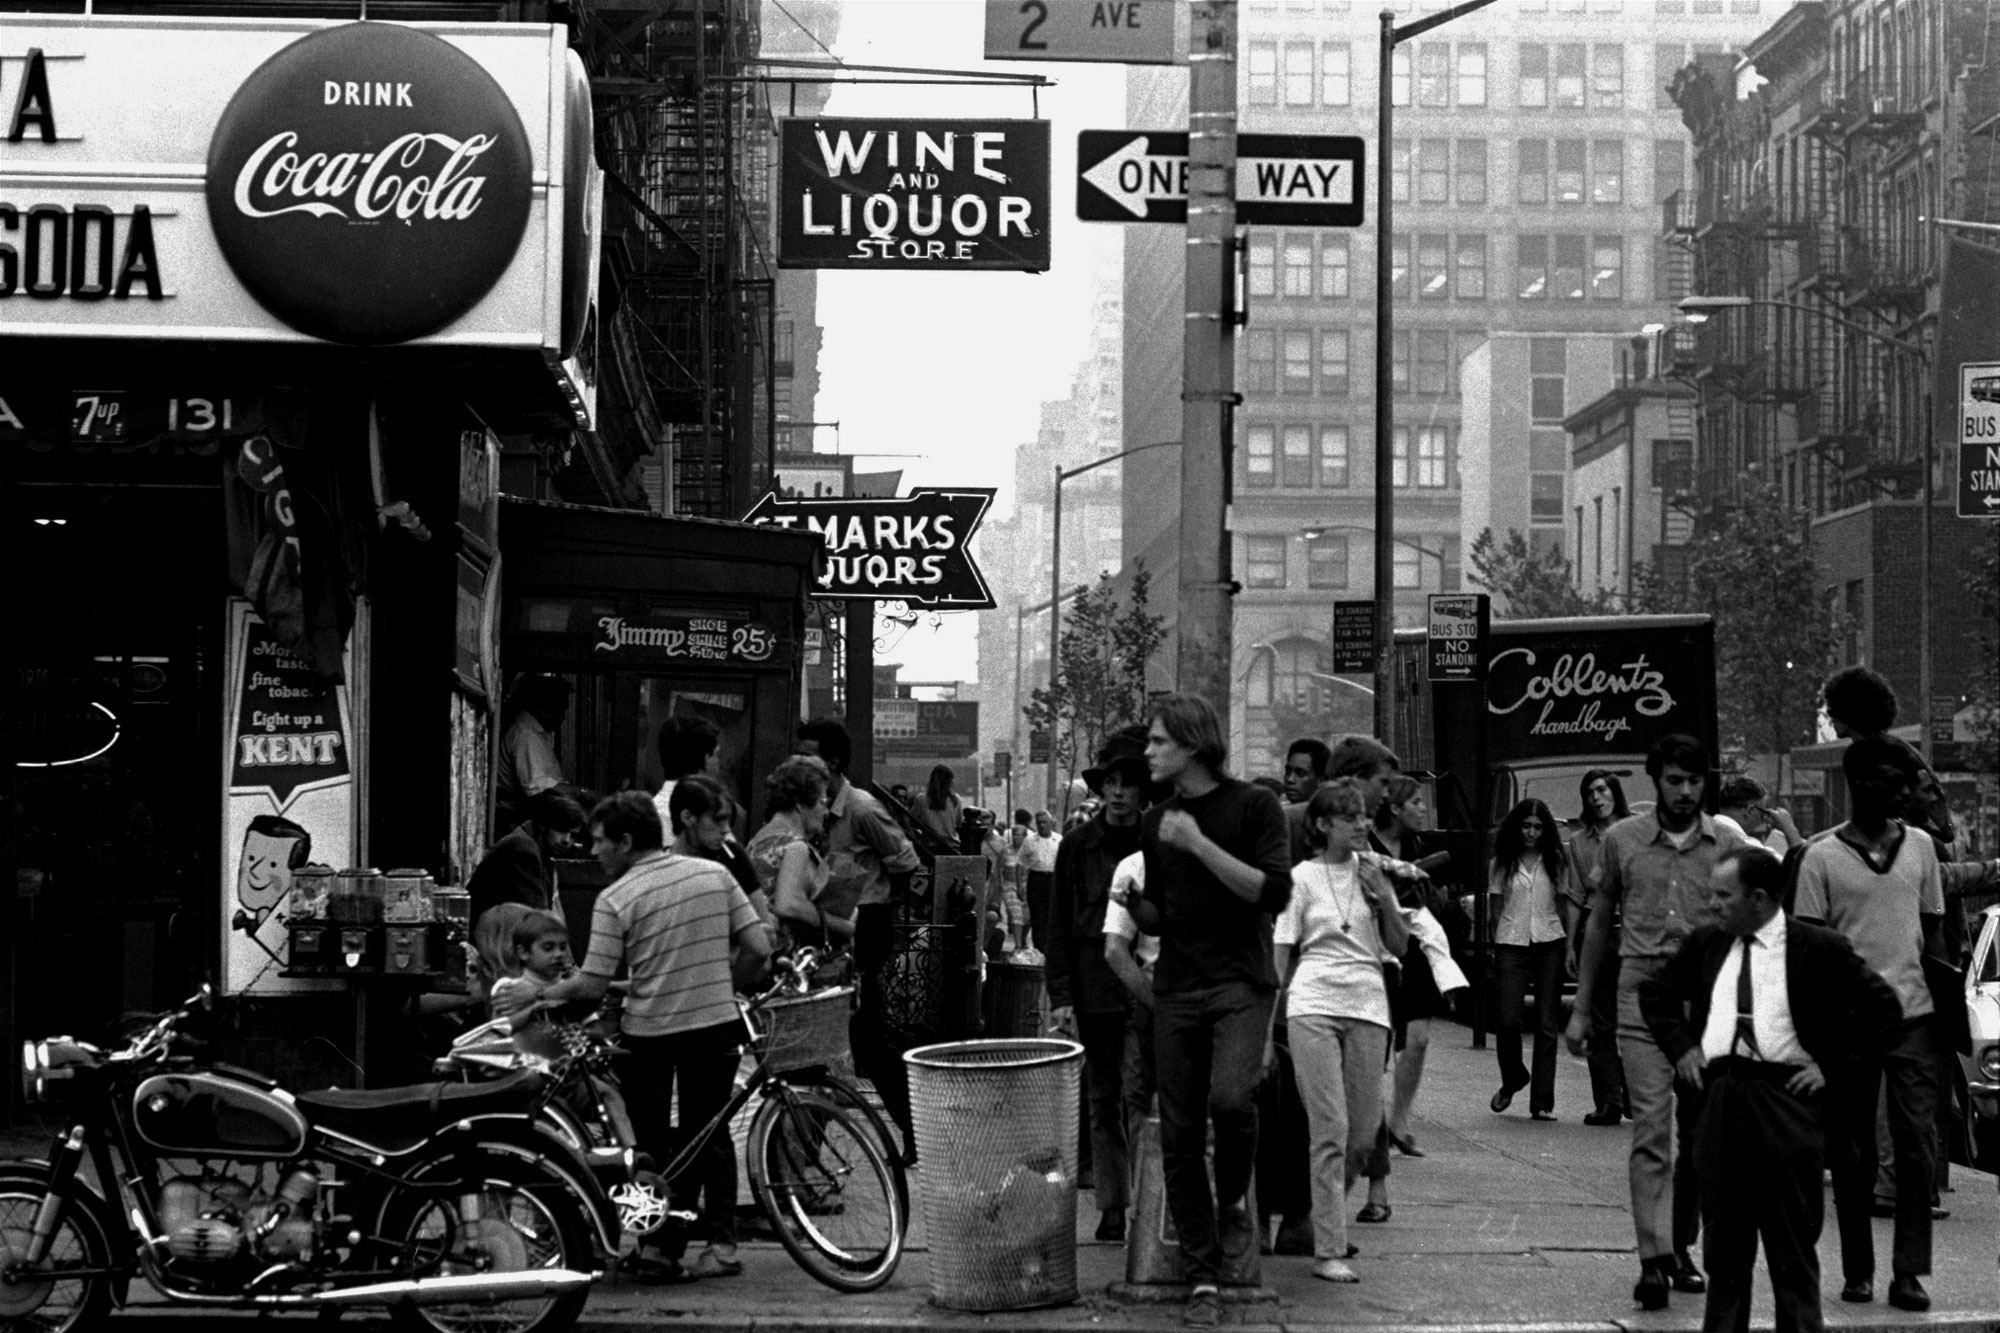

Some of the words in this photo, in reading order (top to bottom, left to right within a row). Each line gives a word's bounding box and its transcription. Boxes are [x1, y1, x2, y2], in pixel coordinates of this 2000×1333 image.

[1018, 0, 1048, 50] 2
[1091, 3, 1142, 28] AVE
[324, 80, 413, 108] DRINK
[813, 130, 1012, 185] WINE
[234, 130, 498, 220] Coca-Cola
[888, 172, 940, 191] AND
[1256, 163, 1340, 198] WAY
[802, 191, 1037, 241] LIQUOR
[848, 239, 978, 260] STORE
[168, 397, 232, 431] 131
[1965, 416, 1997, 438] BUS
[808, 515, 956, 552] MARKS
[595, 617, 688, 657] Jimmy
[687, 633, 728, 649] SHINE
[689, 619, 728, 633] SHOE
[1432, 624, 1453, 636] BUS
[252, 641, 299, 657] Mor
[1445, 640, 1469, 652] NO
[248, 671, 281, 690] fine
[1488, 647, 1677, 717] Coblentz
[252, 710, 290, 732] Light
[293, 713, 312, 729] up
[314, 714, 324, 725] a
[1530, 700, 1632, 742] handbags
[239, 731, 342, 767] KENT
